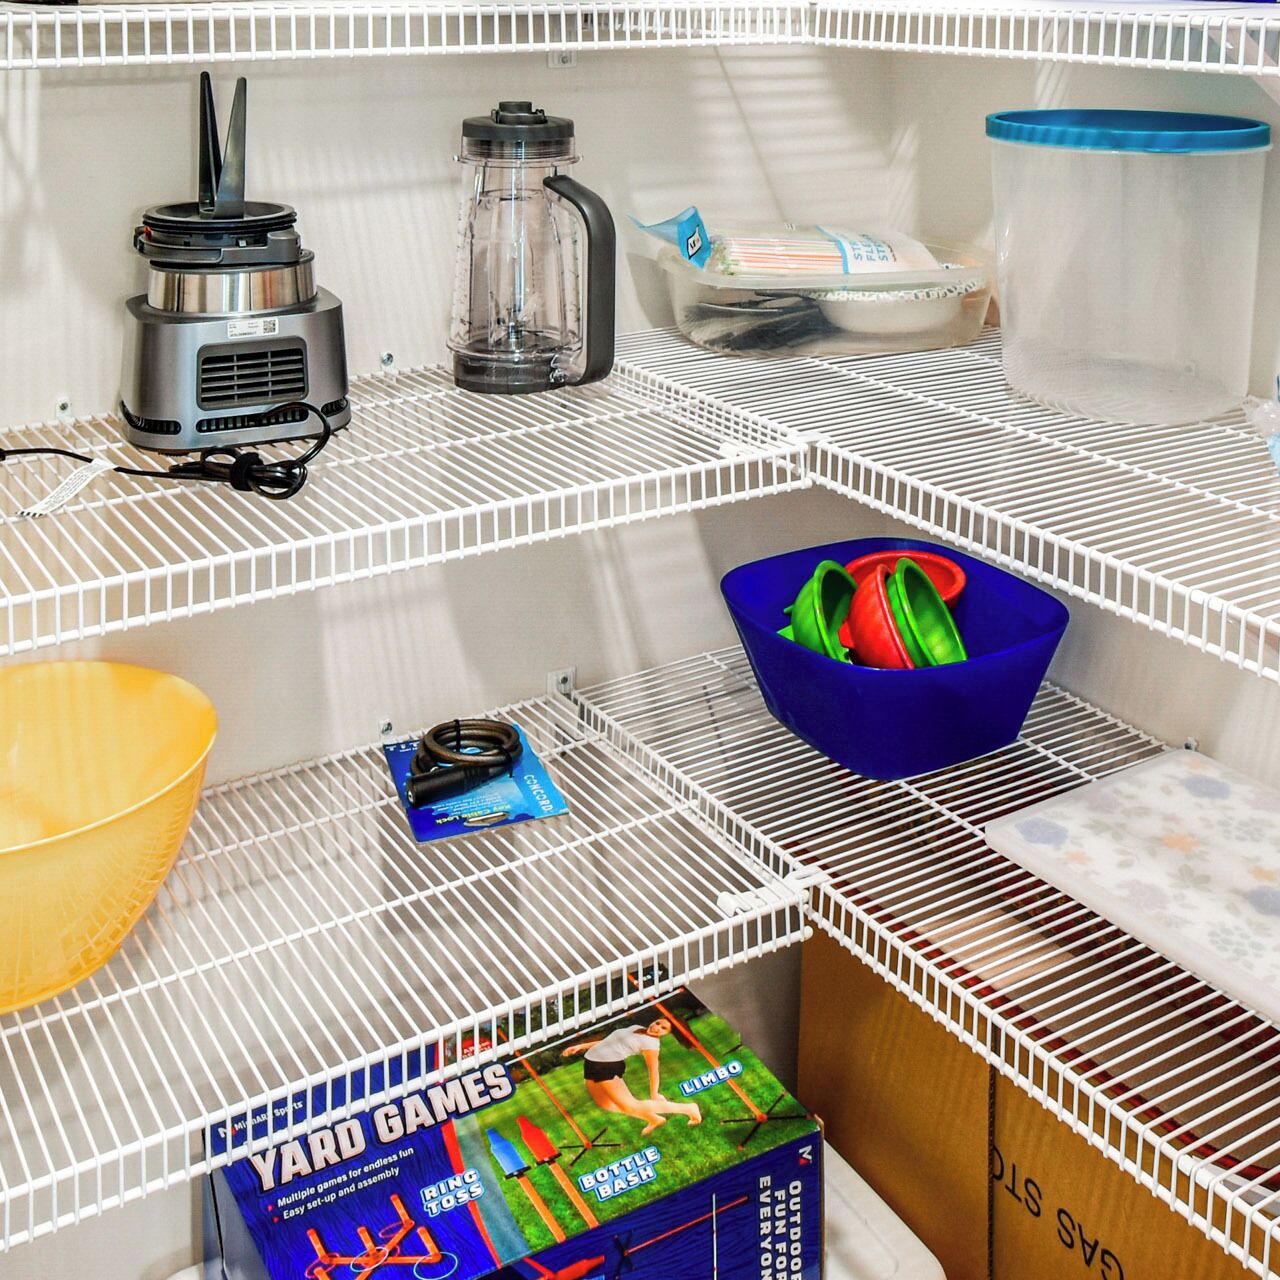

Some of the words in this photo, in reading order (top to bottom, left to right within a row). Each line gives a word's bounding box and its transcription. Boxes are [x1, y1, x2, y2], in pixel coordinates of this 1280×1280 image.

[523, 774, 554, 812] CONCORD
[682, 1061, 742, 1095] LIMBO
[250, 1117, 366, 1192] YARD
[372, 1063, 513, 1144] GAMES
[277, 1186, 316, 1208] Multiple
[317, 1174, 348, 1193] games
[349, 1166, 363, 1180] for
[363, 1154, 398, 1175] endless
[398, 1146, 414, 1160] fun
[423, 1169, 478, 1202] RING
[581, 1147, 659, 1190] BOTTLE
[596, 1168, 655, 1200] BASH
[282, 1204, 306, 1222] Easy
[306, 1192, 337, 1212] set-up
[338, 1183, 356, 1198] and
[357, 1166, 400, 1191] assembly
[425, 1183, 483, 1215] TOSS
[773, 1189, 787, 1235] FUN
[1056, 1207, 1125, 1280] GAS
